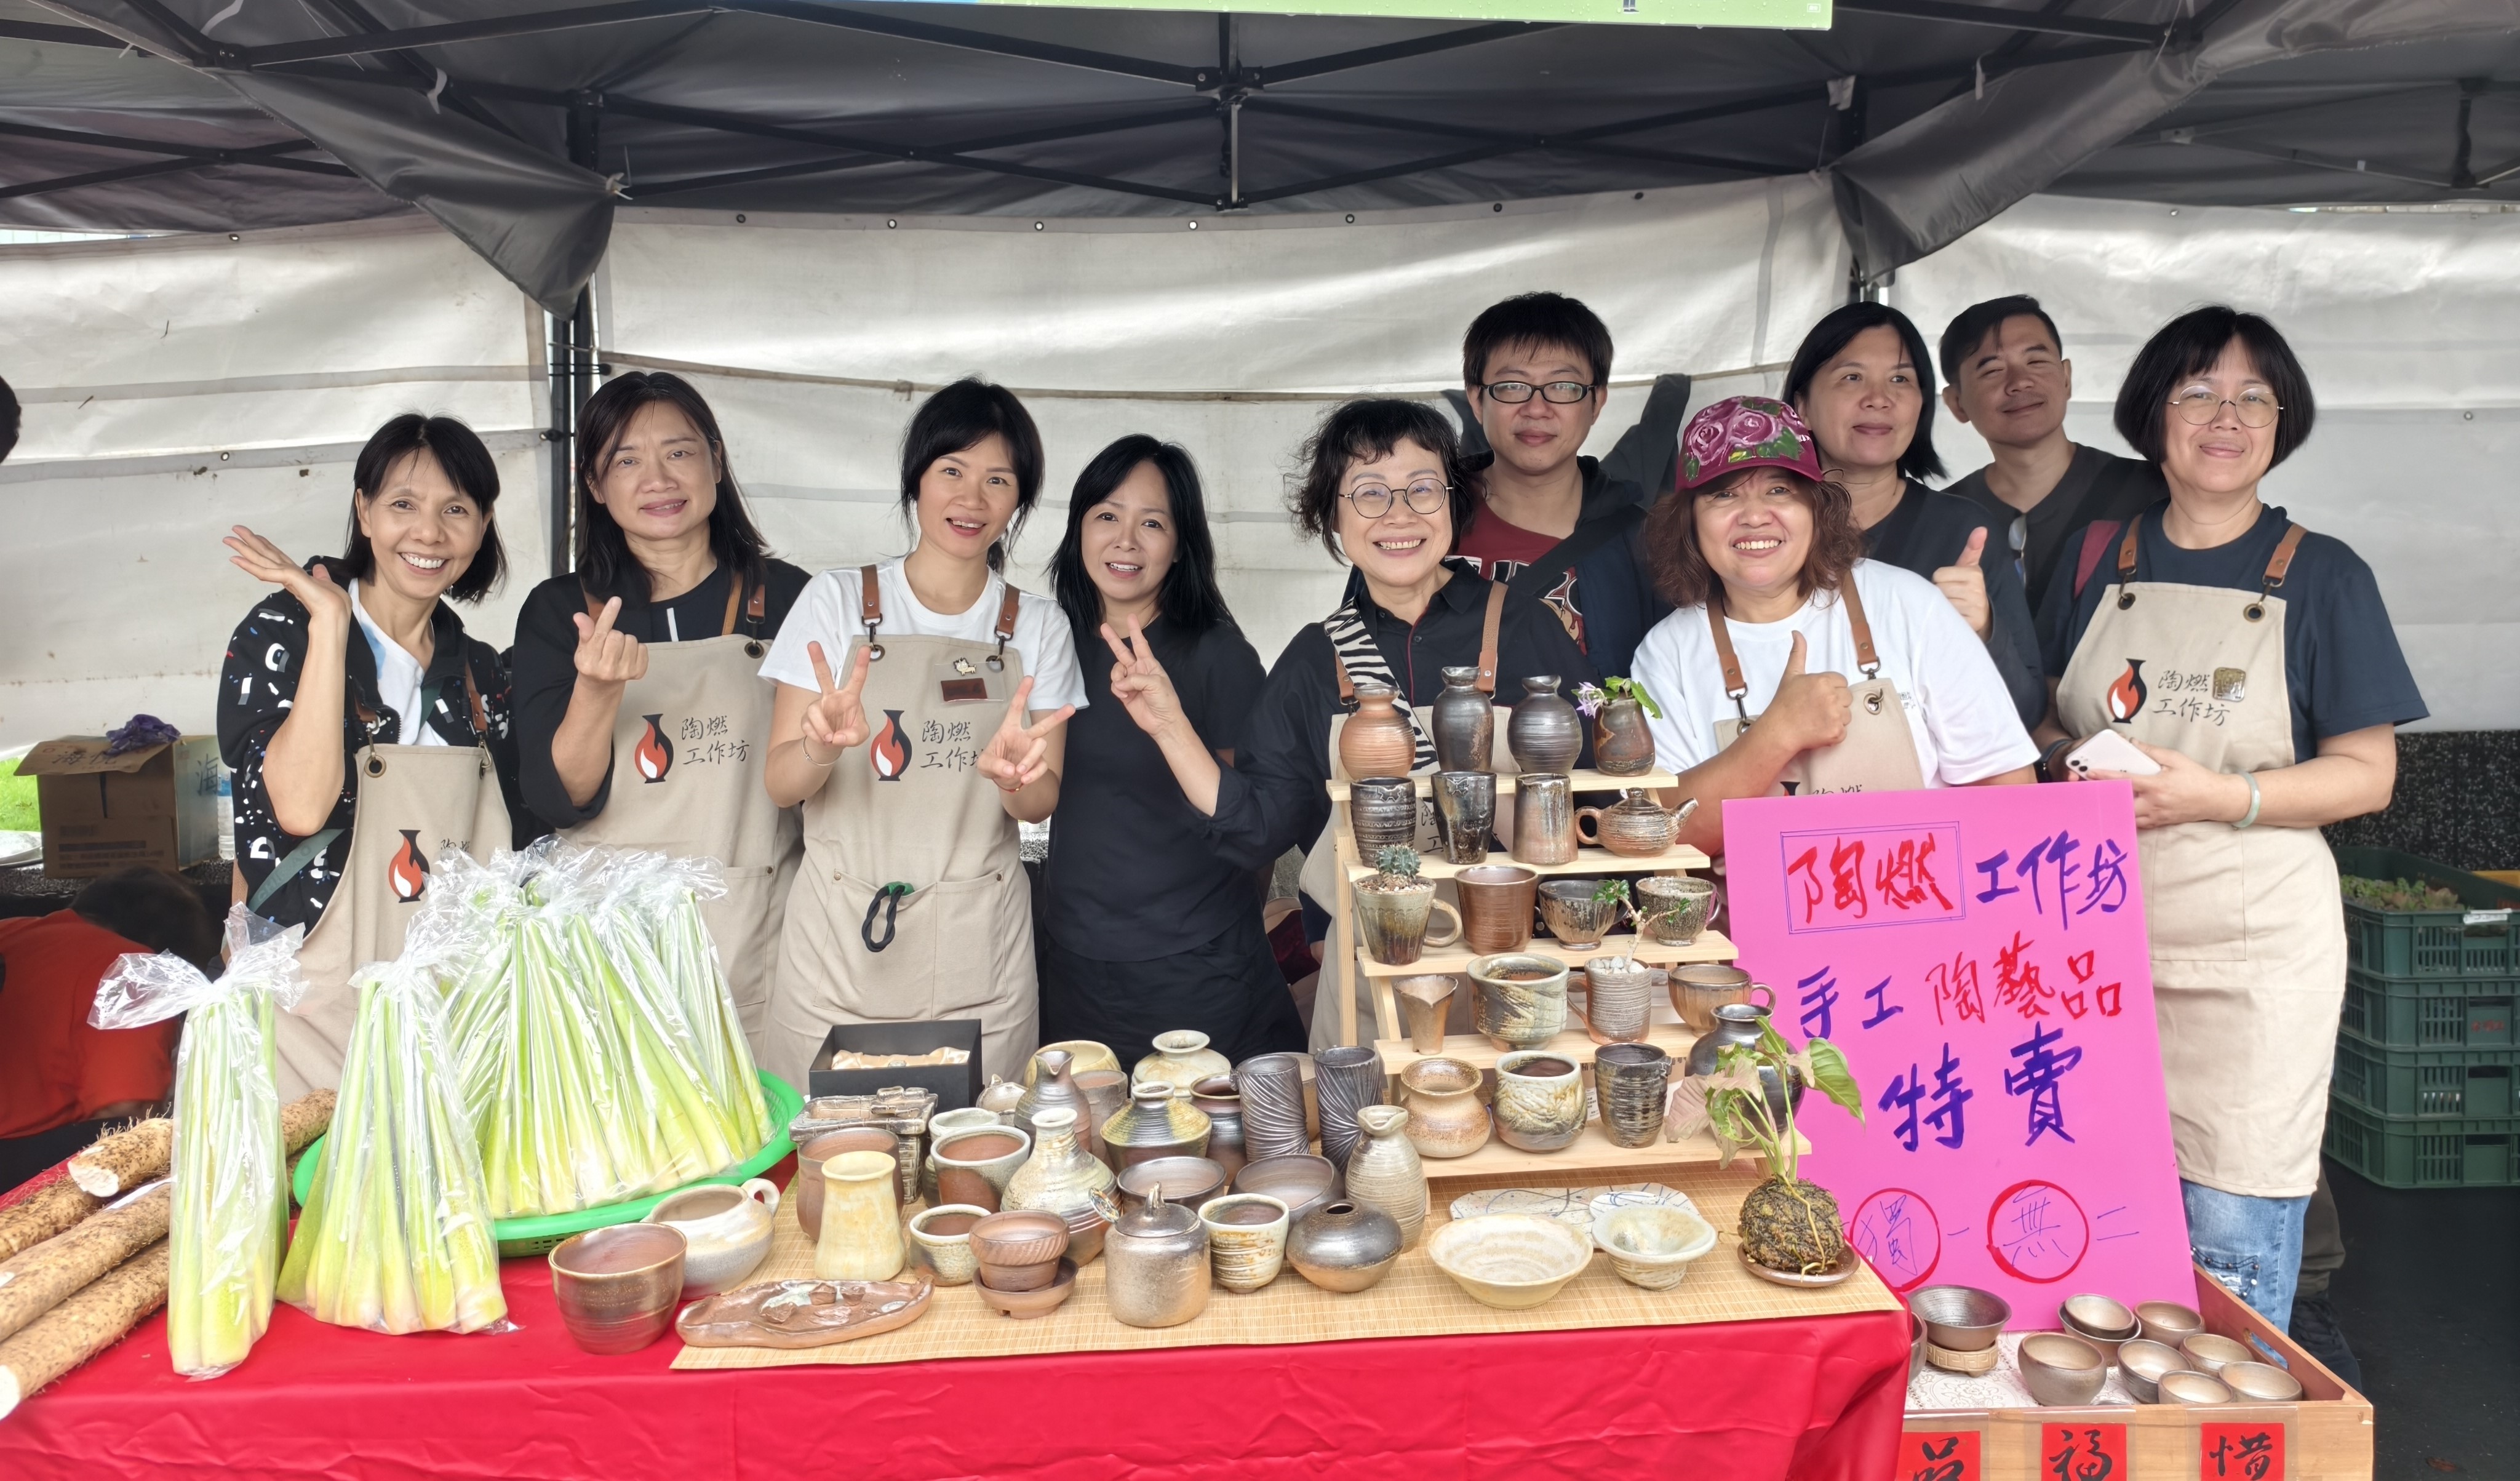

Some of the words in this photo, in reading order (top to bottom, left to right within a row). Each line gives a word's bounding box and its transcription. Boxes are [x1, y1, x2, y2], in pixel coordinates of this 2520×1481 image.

[2157, 669, 2211, 692] 陶燃
[681, 714, 728, 740] 陶燃
[2153, 696, 2230, 727] 工作坊
[922, 719, 971, 744] 陶燃
[682, 739, 750, 765] 工作坊
[1787, 832, 1955, 924] 陶燃
[1976, 829, 2129, 930] 工作坊
[1924, 930, 2123, 1026] 陶藝品
[1878, 1021, 2083, 1153] 特賣
[2048, 1429, 2113, 1481] 福
[2210, 1433, 2275, 1481] 惜
